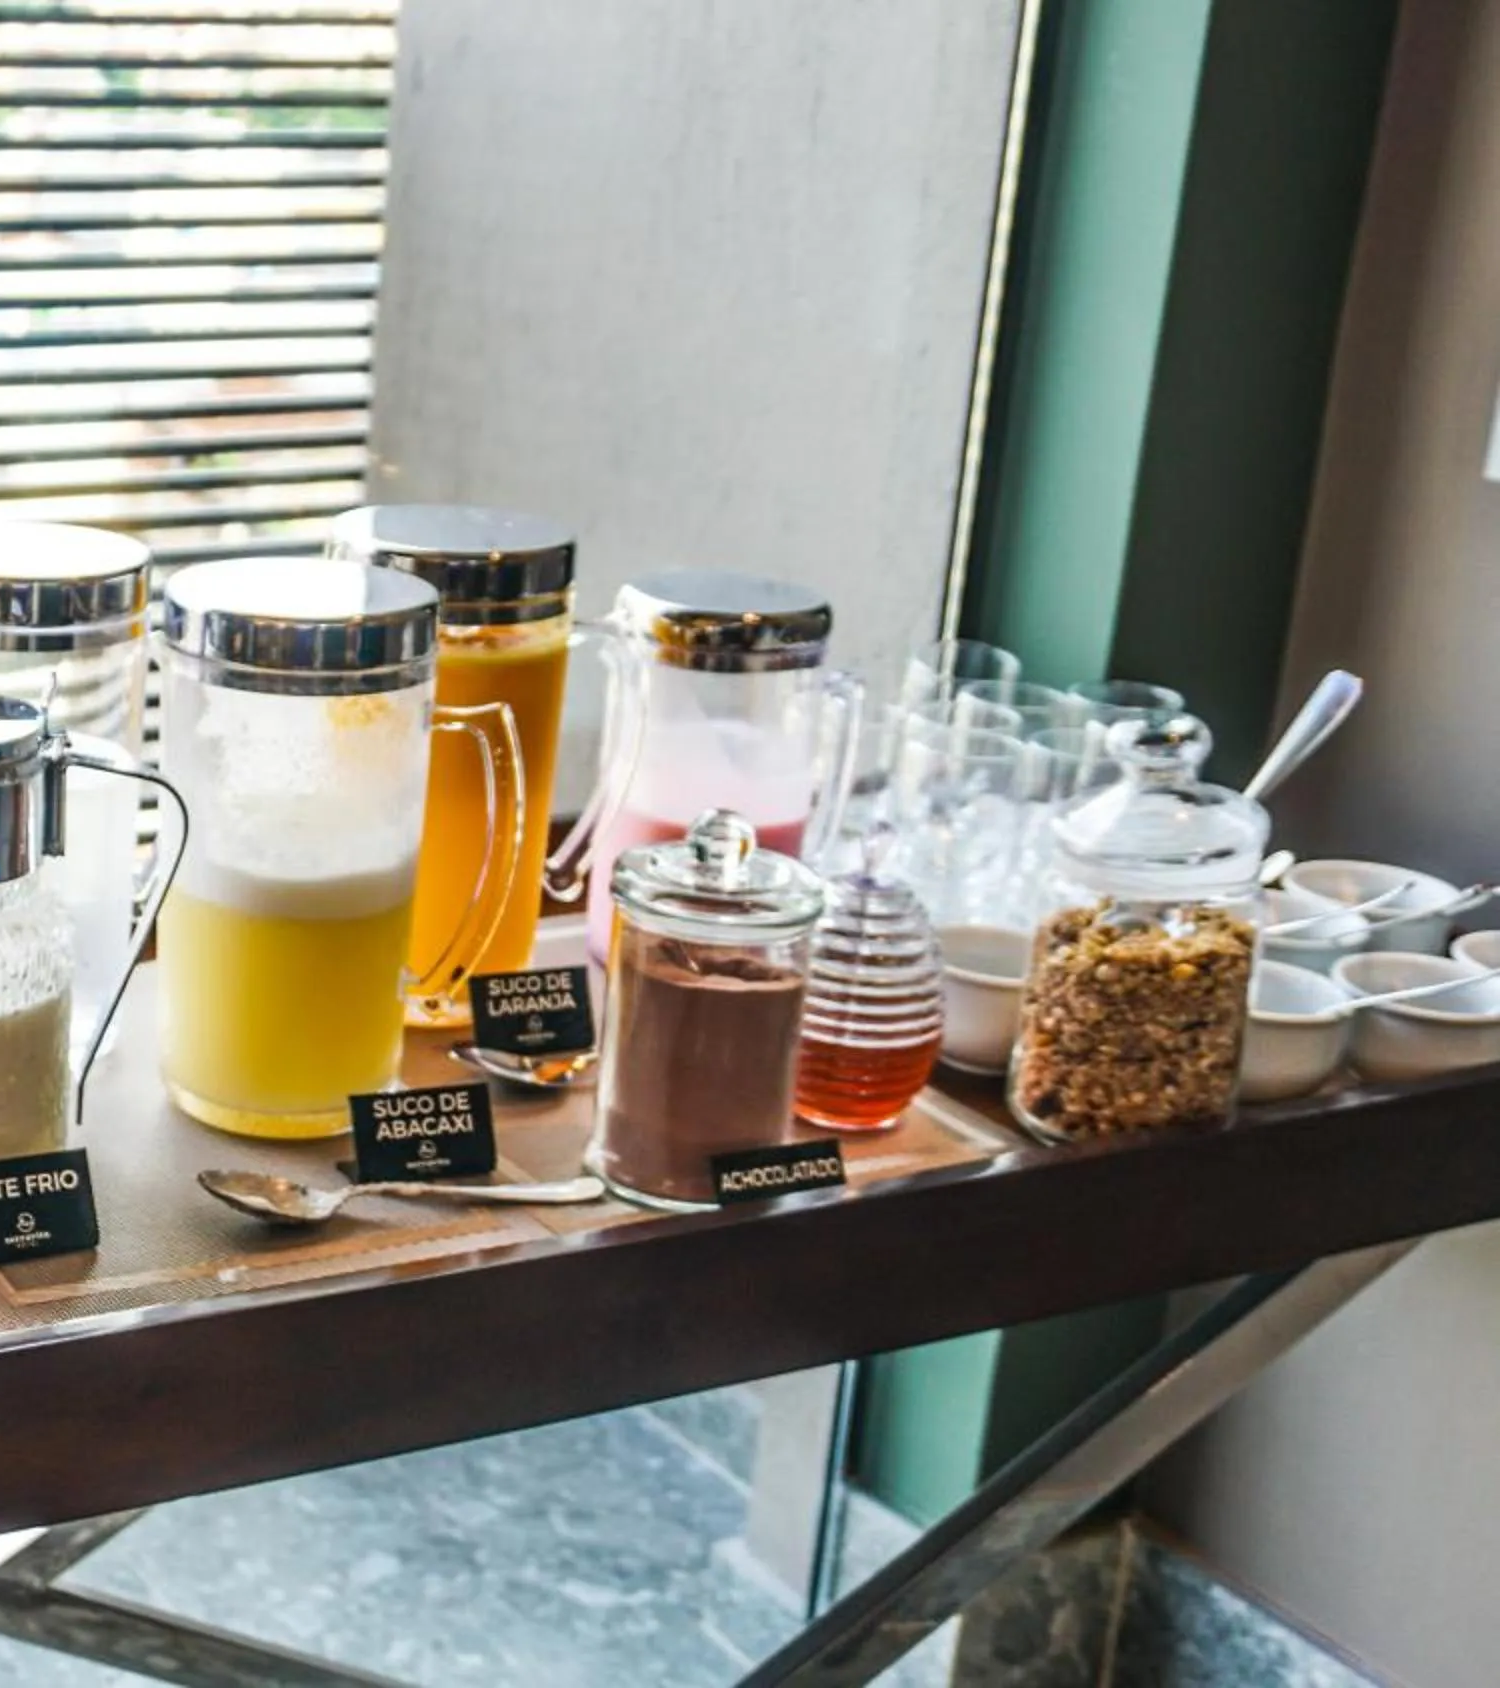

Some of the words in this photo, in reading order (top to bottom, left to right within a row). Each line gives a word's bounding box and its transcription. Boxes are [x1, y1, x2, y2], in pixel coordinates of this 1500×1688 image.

[488, 975, 541, 996] SUCO
[545, 971, 573, 991] DE
[488, 992, 577, 1017] LARANJA
[373, 1096, 435, 1119] SUCO
[439, 1091, 471, 1112] DE
[376, 1113, 474, 1141] ABACAXI
[25, 1169, 79, 1195] FRIO
[721, 1157, 839, 1192] ACHOCOLATADO
